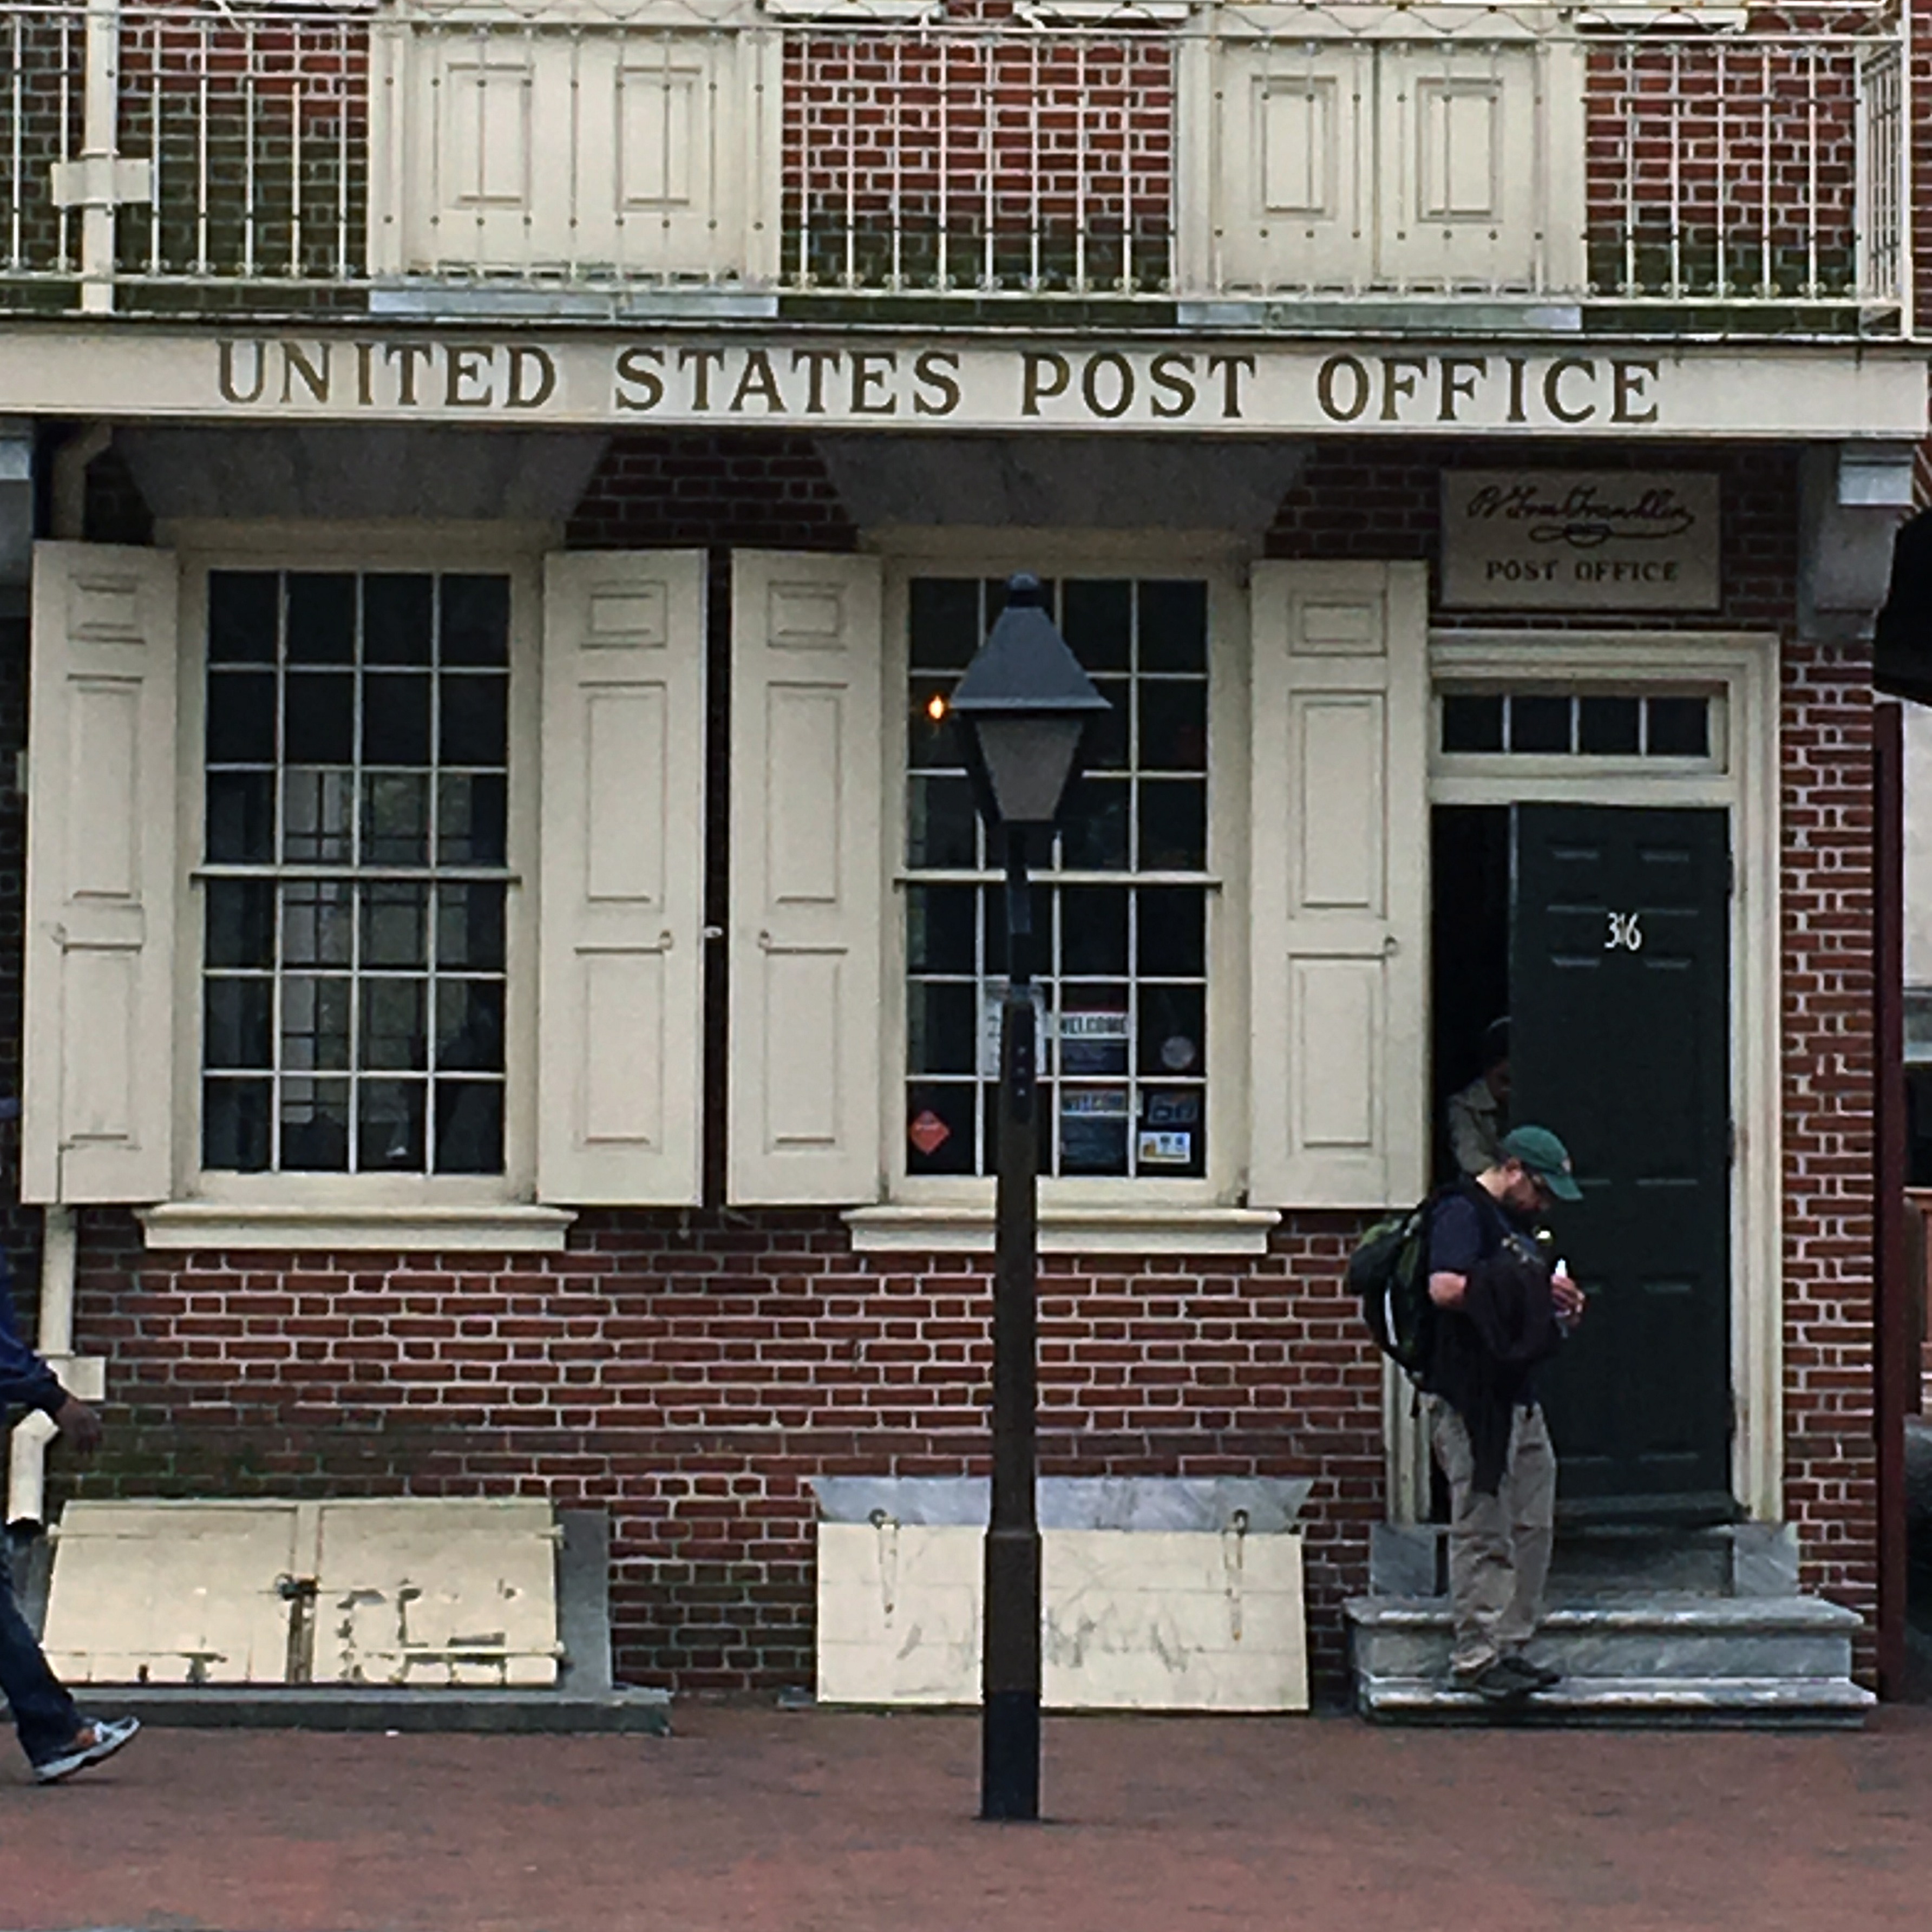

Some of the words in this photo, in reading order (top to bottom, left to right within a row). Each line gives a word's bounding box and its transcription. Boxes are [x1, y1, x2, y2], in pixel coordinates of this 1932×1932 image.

[218, 340, 556, 408] UNITED
[615, 347, 960, 416] STATES
[1021, 352, 1256, 418] POST
[1317, 355, 1660, 423] OFFICE
[1485, 560, 1559, 581] POST
[1574, 560, 1679, 581] OFFICE
